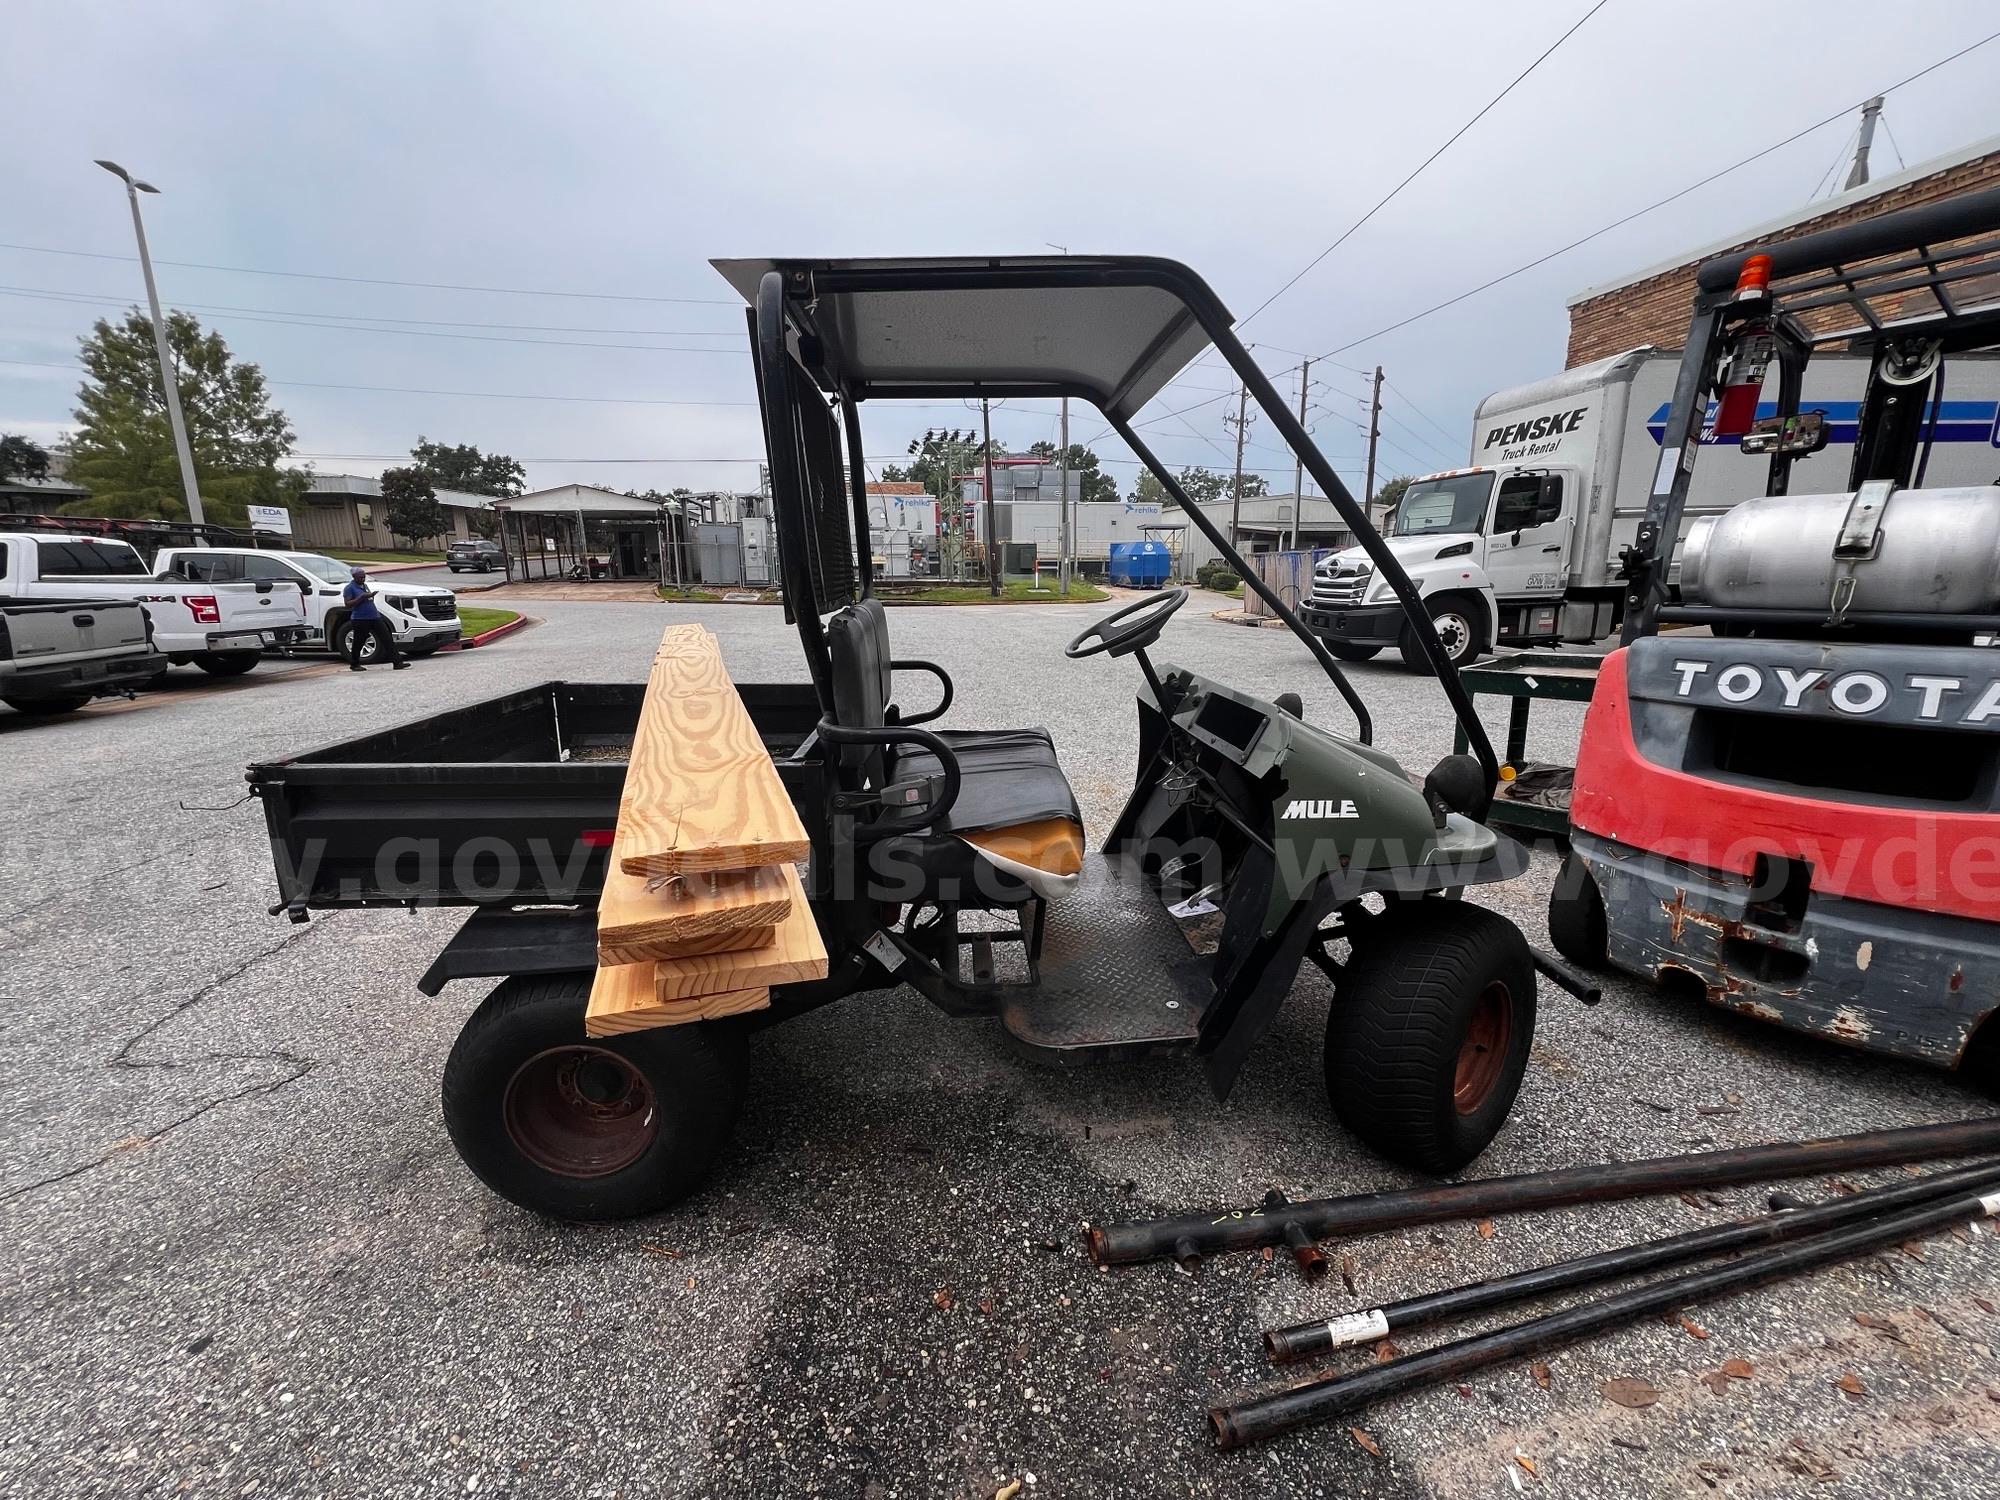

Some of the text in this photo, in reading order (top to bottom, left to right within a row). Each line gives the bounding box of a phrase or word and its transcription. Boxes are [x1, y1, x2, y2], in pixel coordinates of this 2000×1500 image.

[1484, 407, 1589, 450] PENSKE
[1501, 438, 1561, 461] Truck Rental
[905, 499, 931, 507] rehlko
[1280, 799, 1360, 819] MULE
